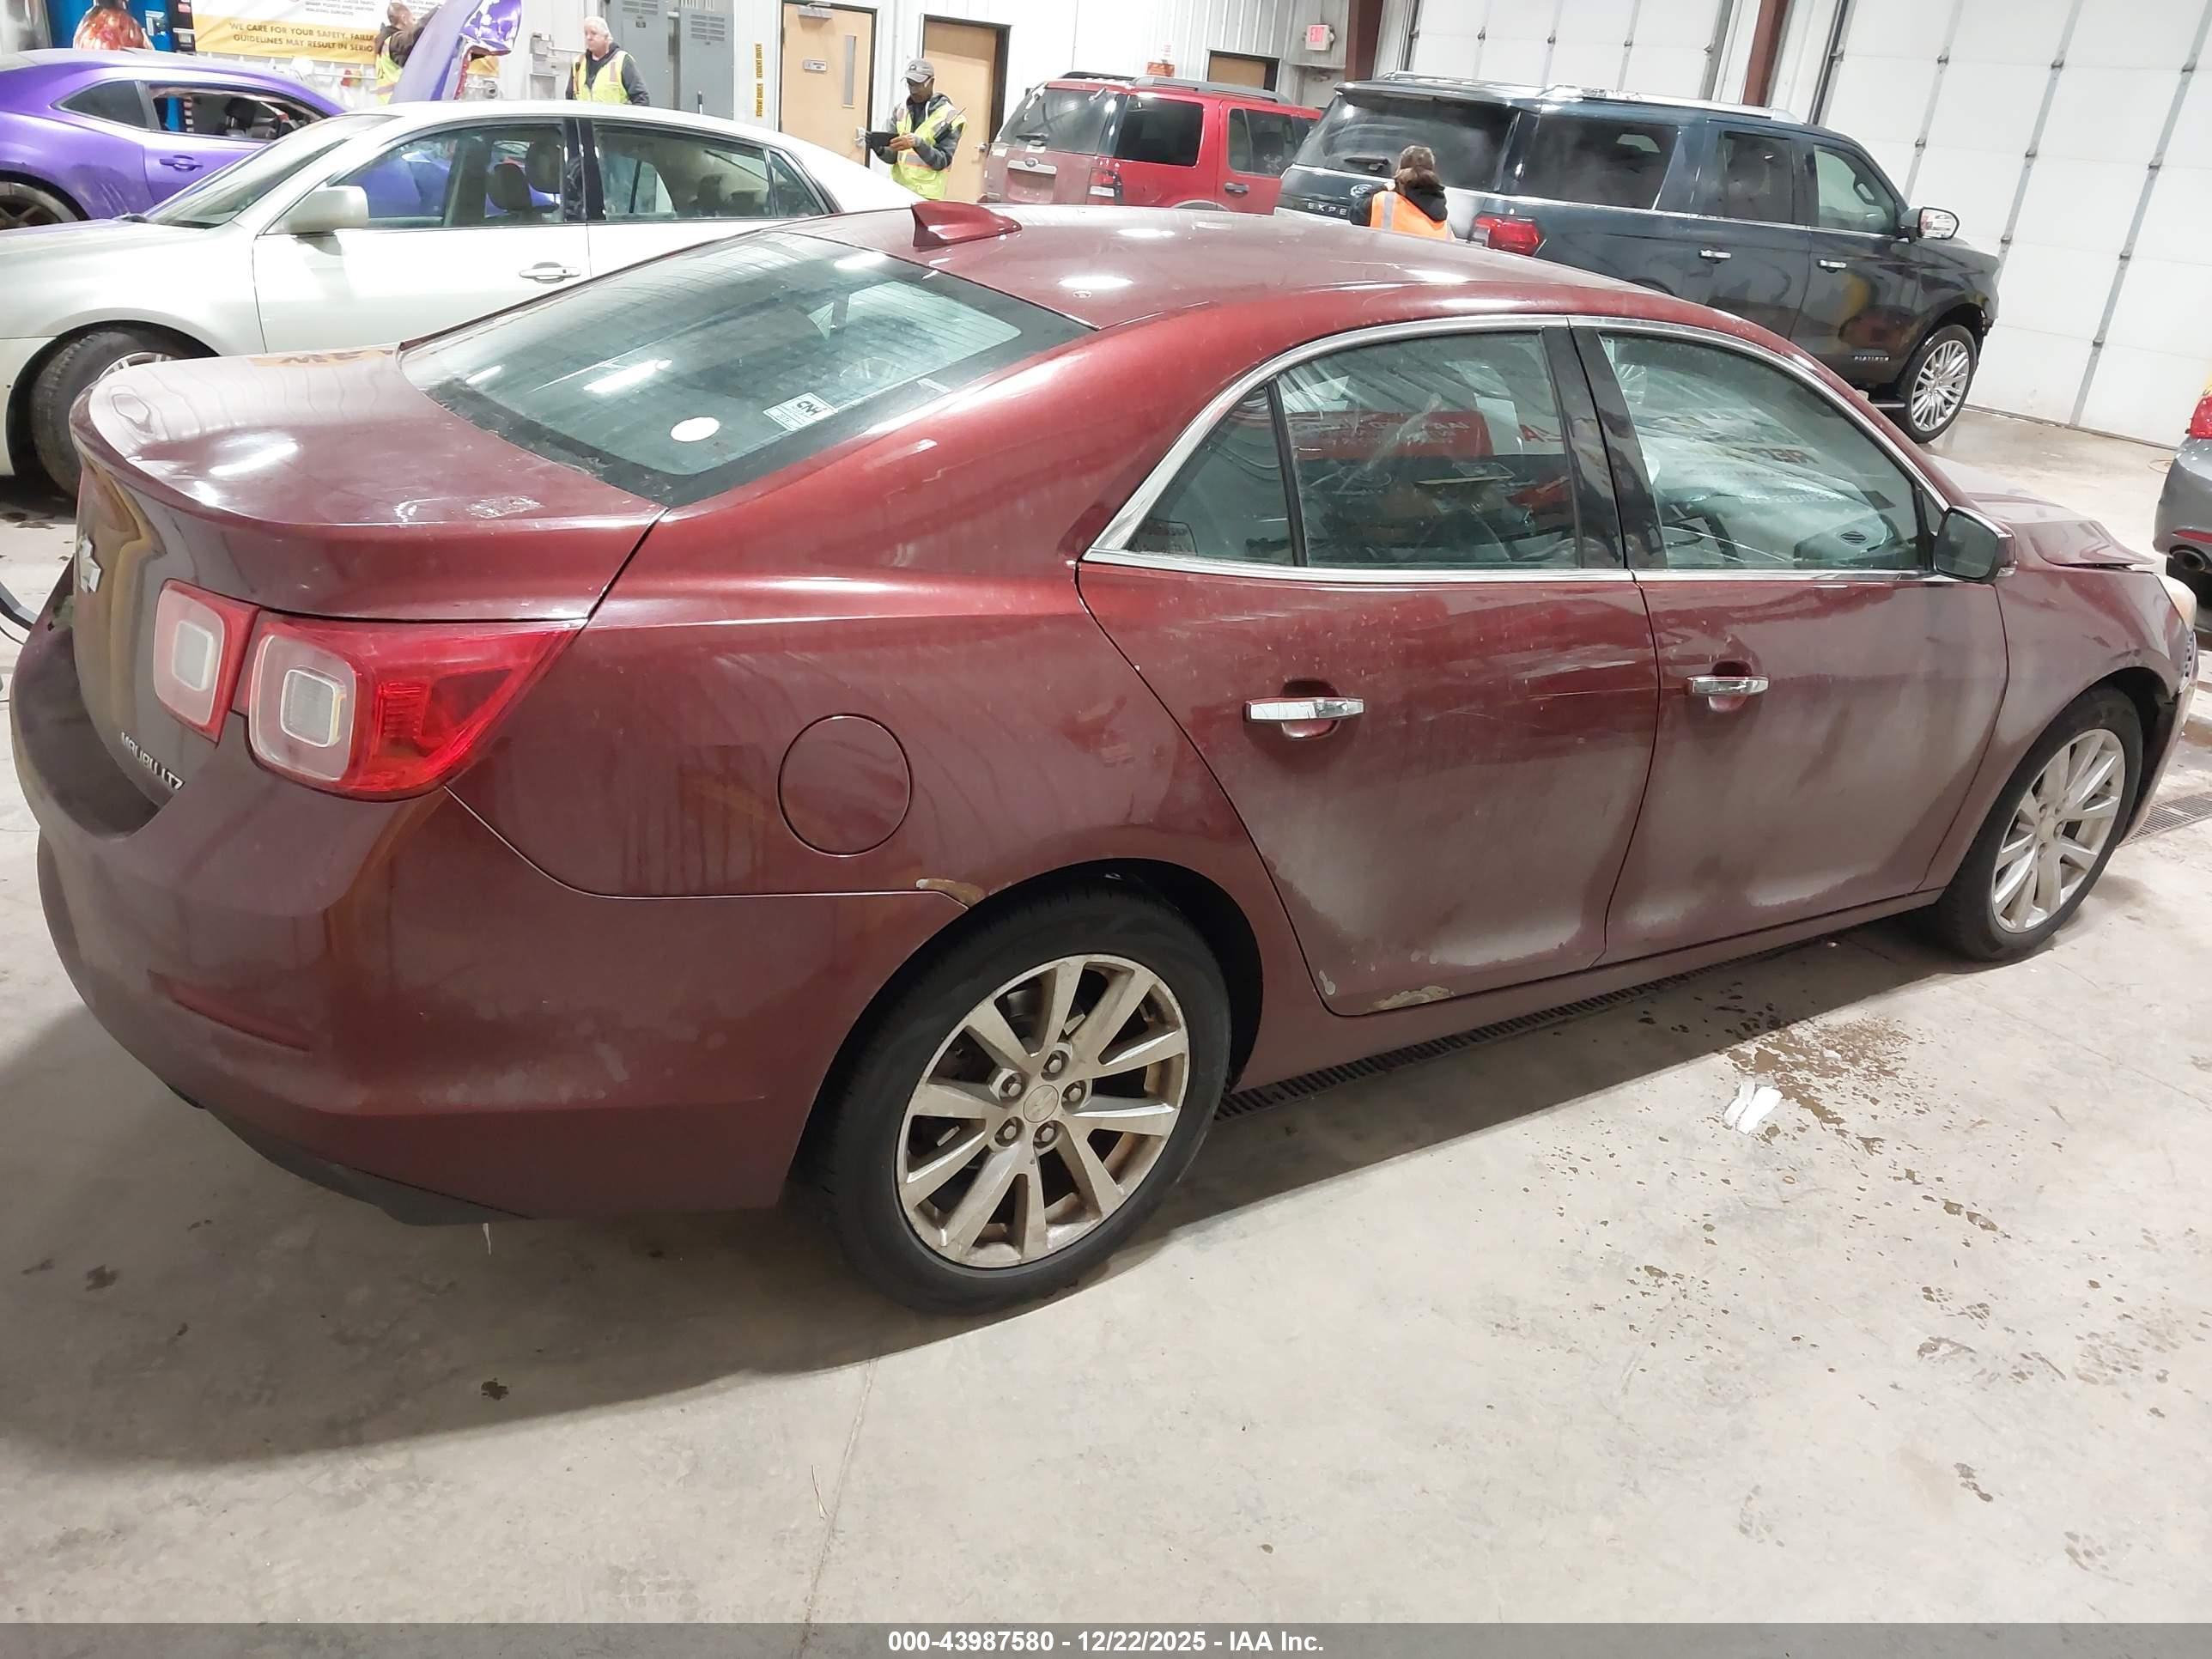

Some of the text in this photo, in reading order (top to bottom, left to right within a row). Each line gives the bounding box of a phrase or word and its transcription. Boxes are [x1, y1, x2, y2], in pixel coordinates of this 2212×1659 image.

[229, 22, 244, 31] WE
[246, 24, 268, 33] CARE
[290, 27, 313, 36] YOUR
[233, 33, 283, 45] GUIDELINES
[307, 40, 337, 49] RESULT
[350, 44, 374, 52] SERIO
[1308, 202, 1348, 216] EXPE
